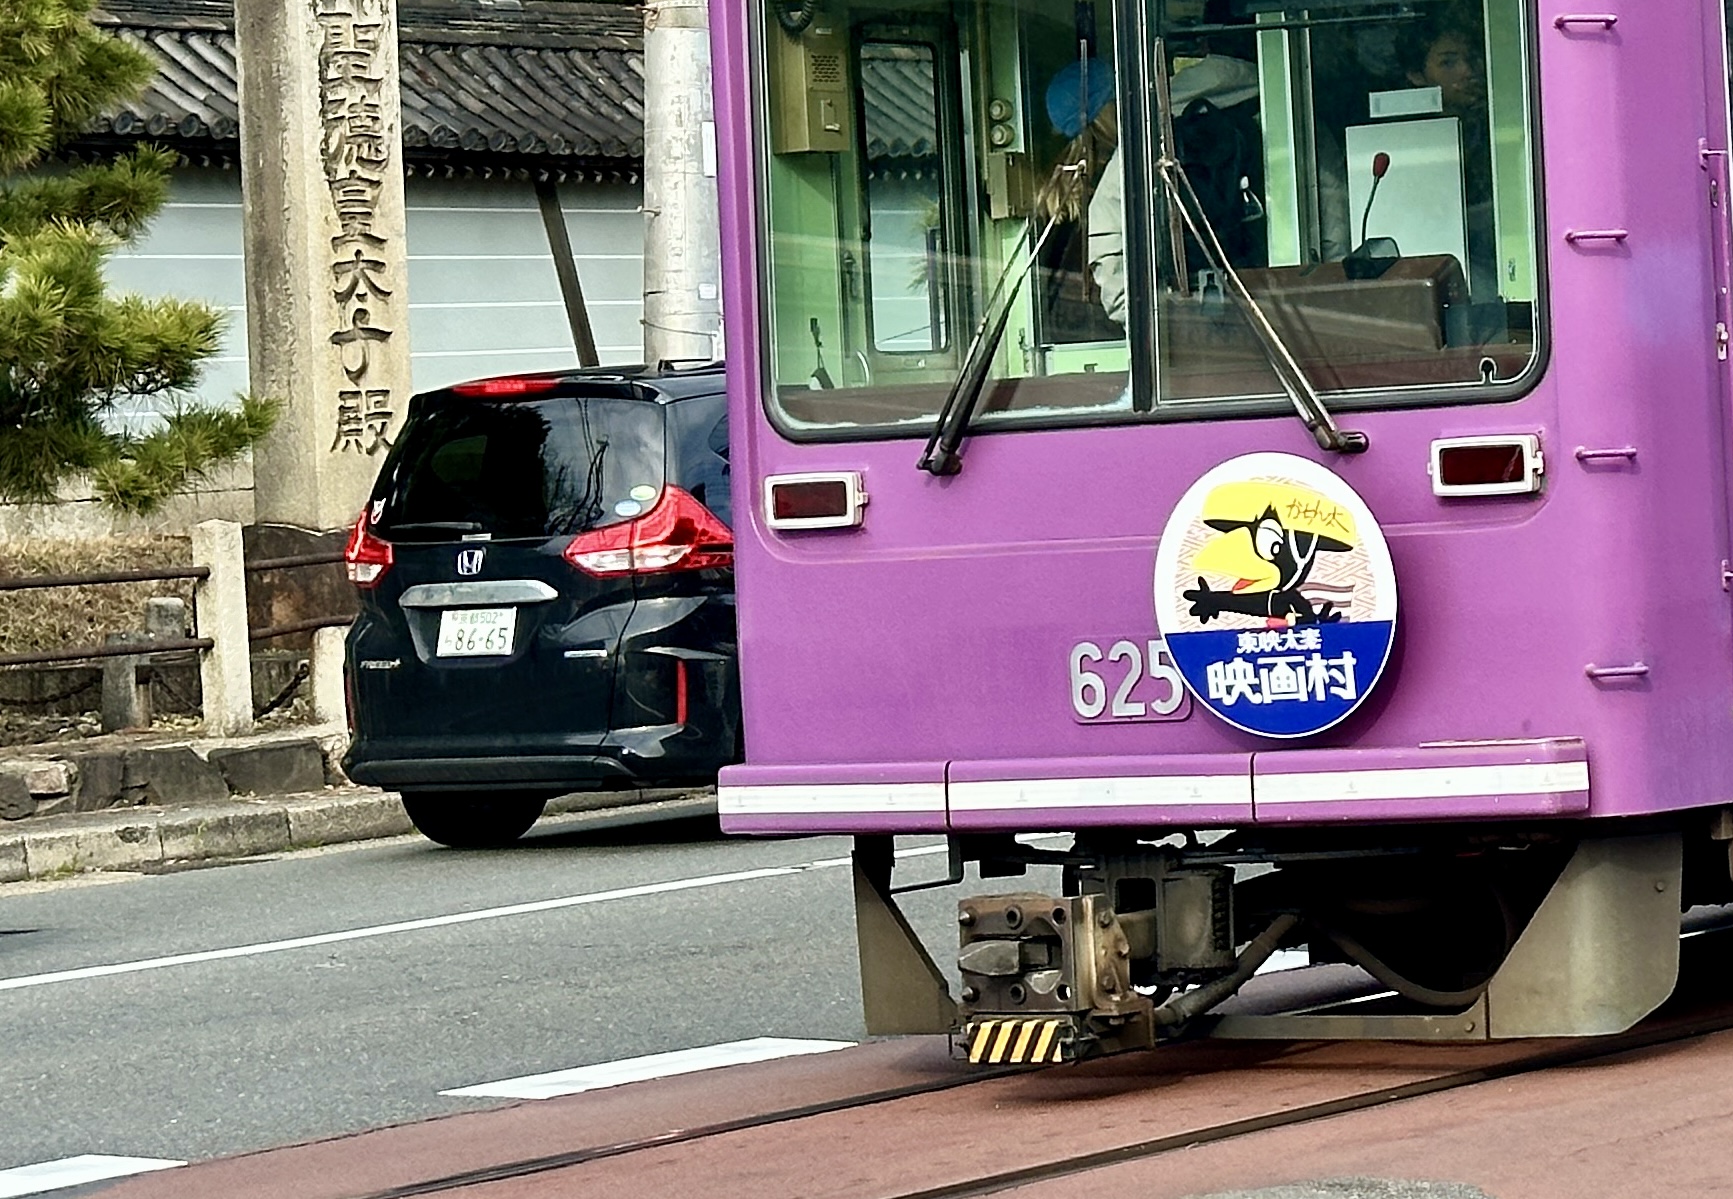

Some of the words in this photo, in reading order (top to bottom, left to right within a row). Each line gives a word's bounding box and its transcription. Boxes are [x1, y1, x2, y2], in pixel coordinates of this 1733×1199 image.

[1237, 629, 1324, 653] 東映太秦
[1069, 639, 1185, 718] 625
[1206, 651, 1358, 706] 映画村
